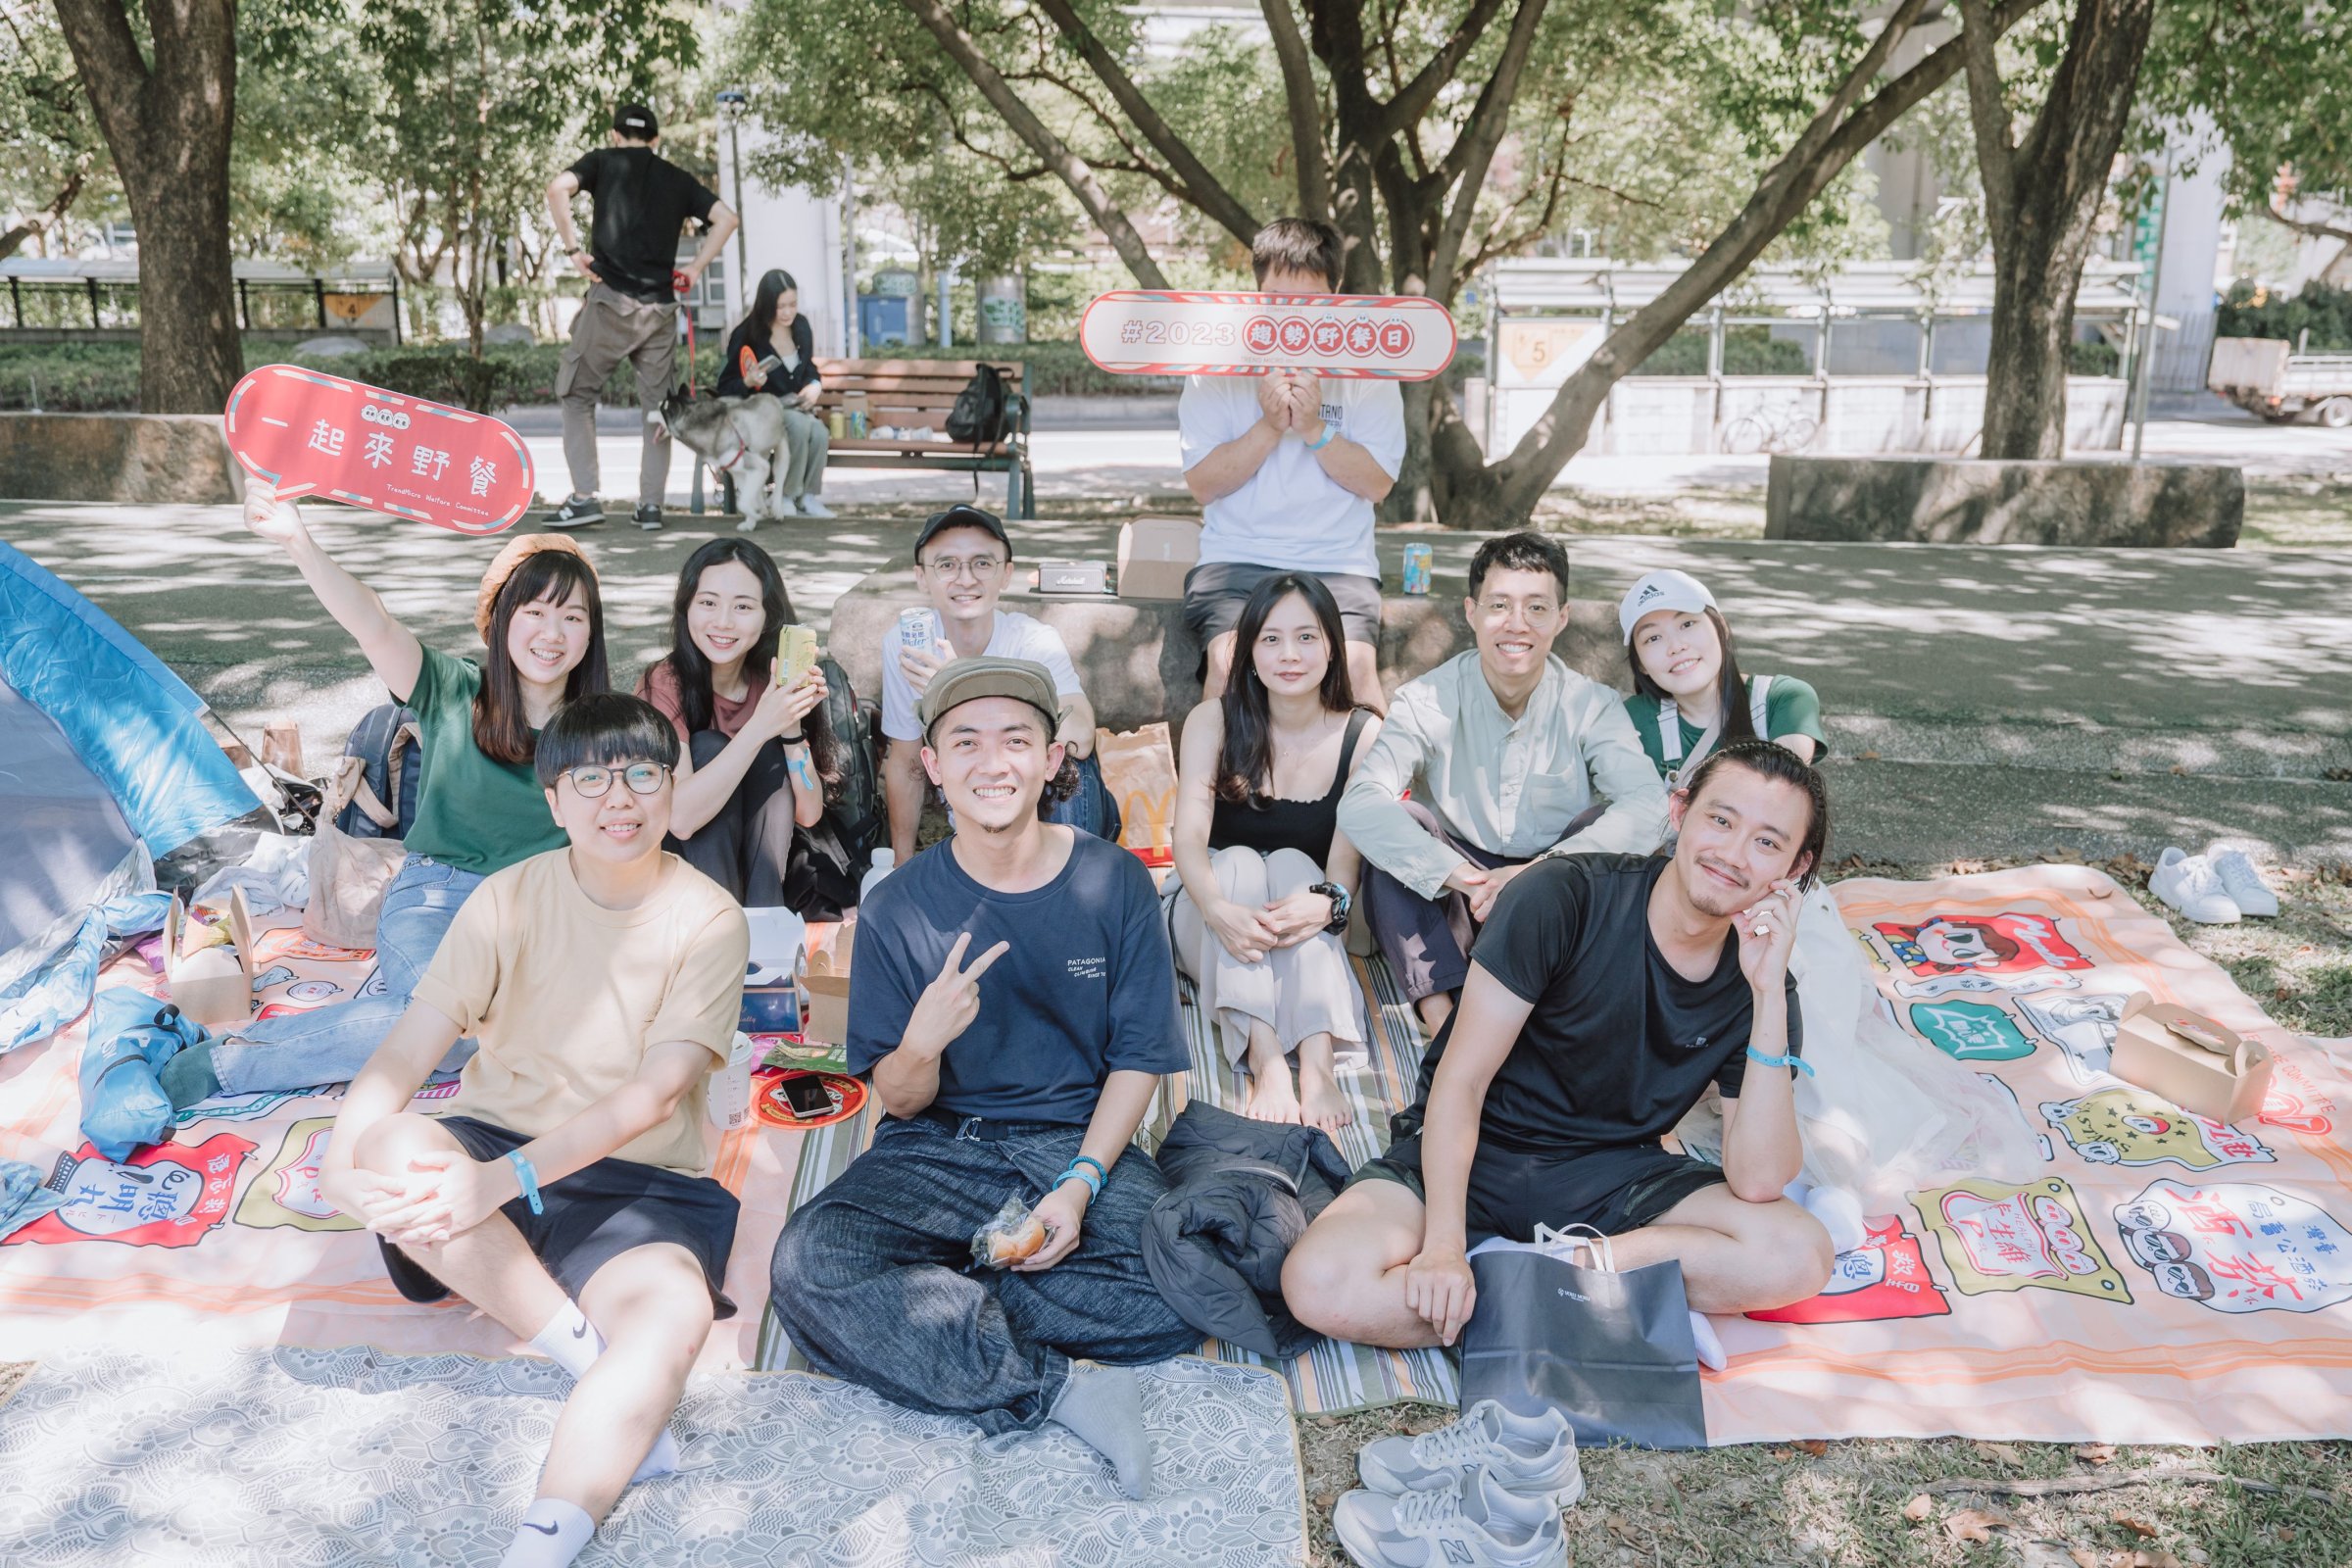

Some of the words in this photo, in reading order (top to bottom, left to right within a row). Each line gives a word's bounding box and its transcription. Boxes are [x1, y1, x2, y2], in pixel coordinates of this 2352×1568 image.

[1120, 319, 1236, 346] #2023
[1249, 322, 1404, 350] 趨勢野餐日
[1533, 340, 1545, 363] 5
[261, 416, 498, 498] 一起來野餐
[386, 483, 421, 499] TrendMicro
[425, 494, 451, 507] Welfare
[455, 502, 490, 516] Committee
[1638, 590, 1665, 607] adidas
[1067, 956, 1106, 966] PATAGONIA
[1439, 1539, 1475, 1564] N
